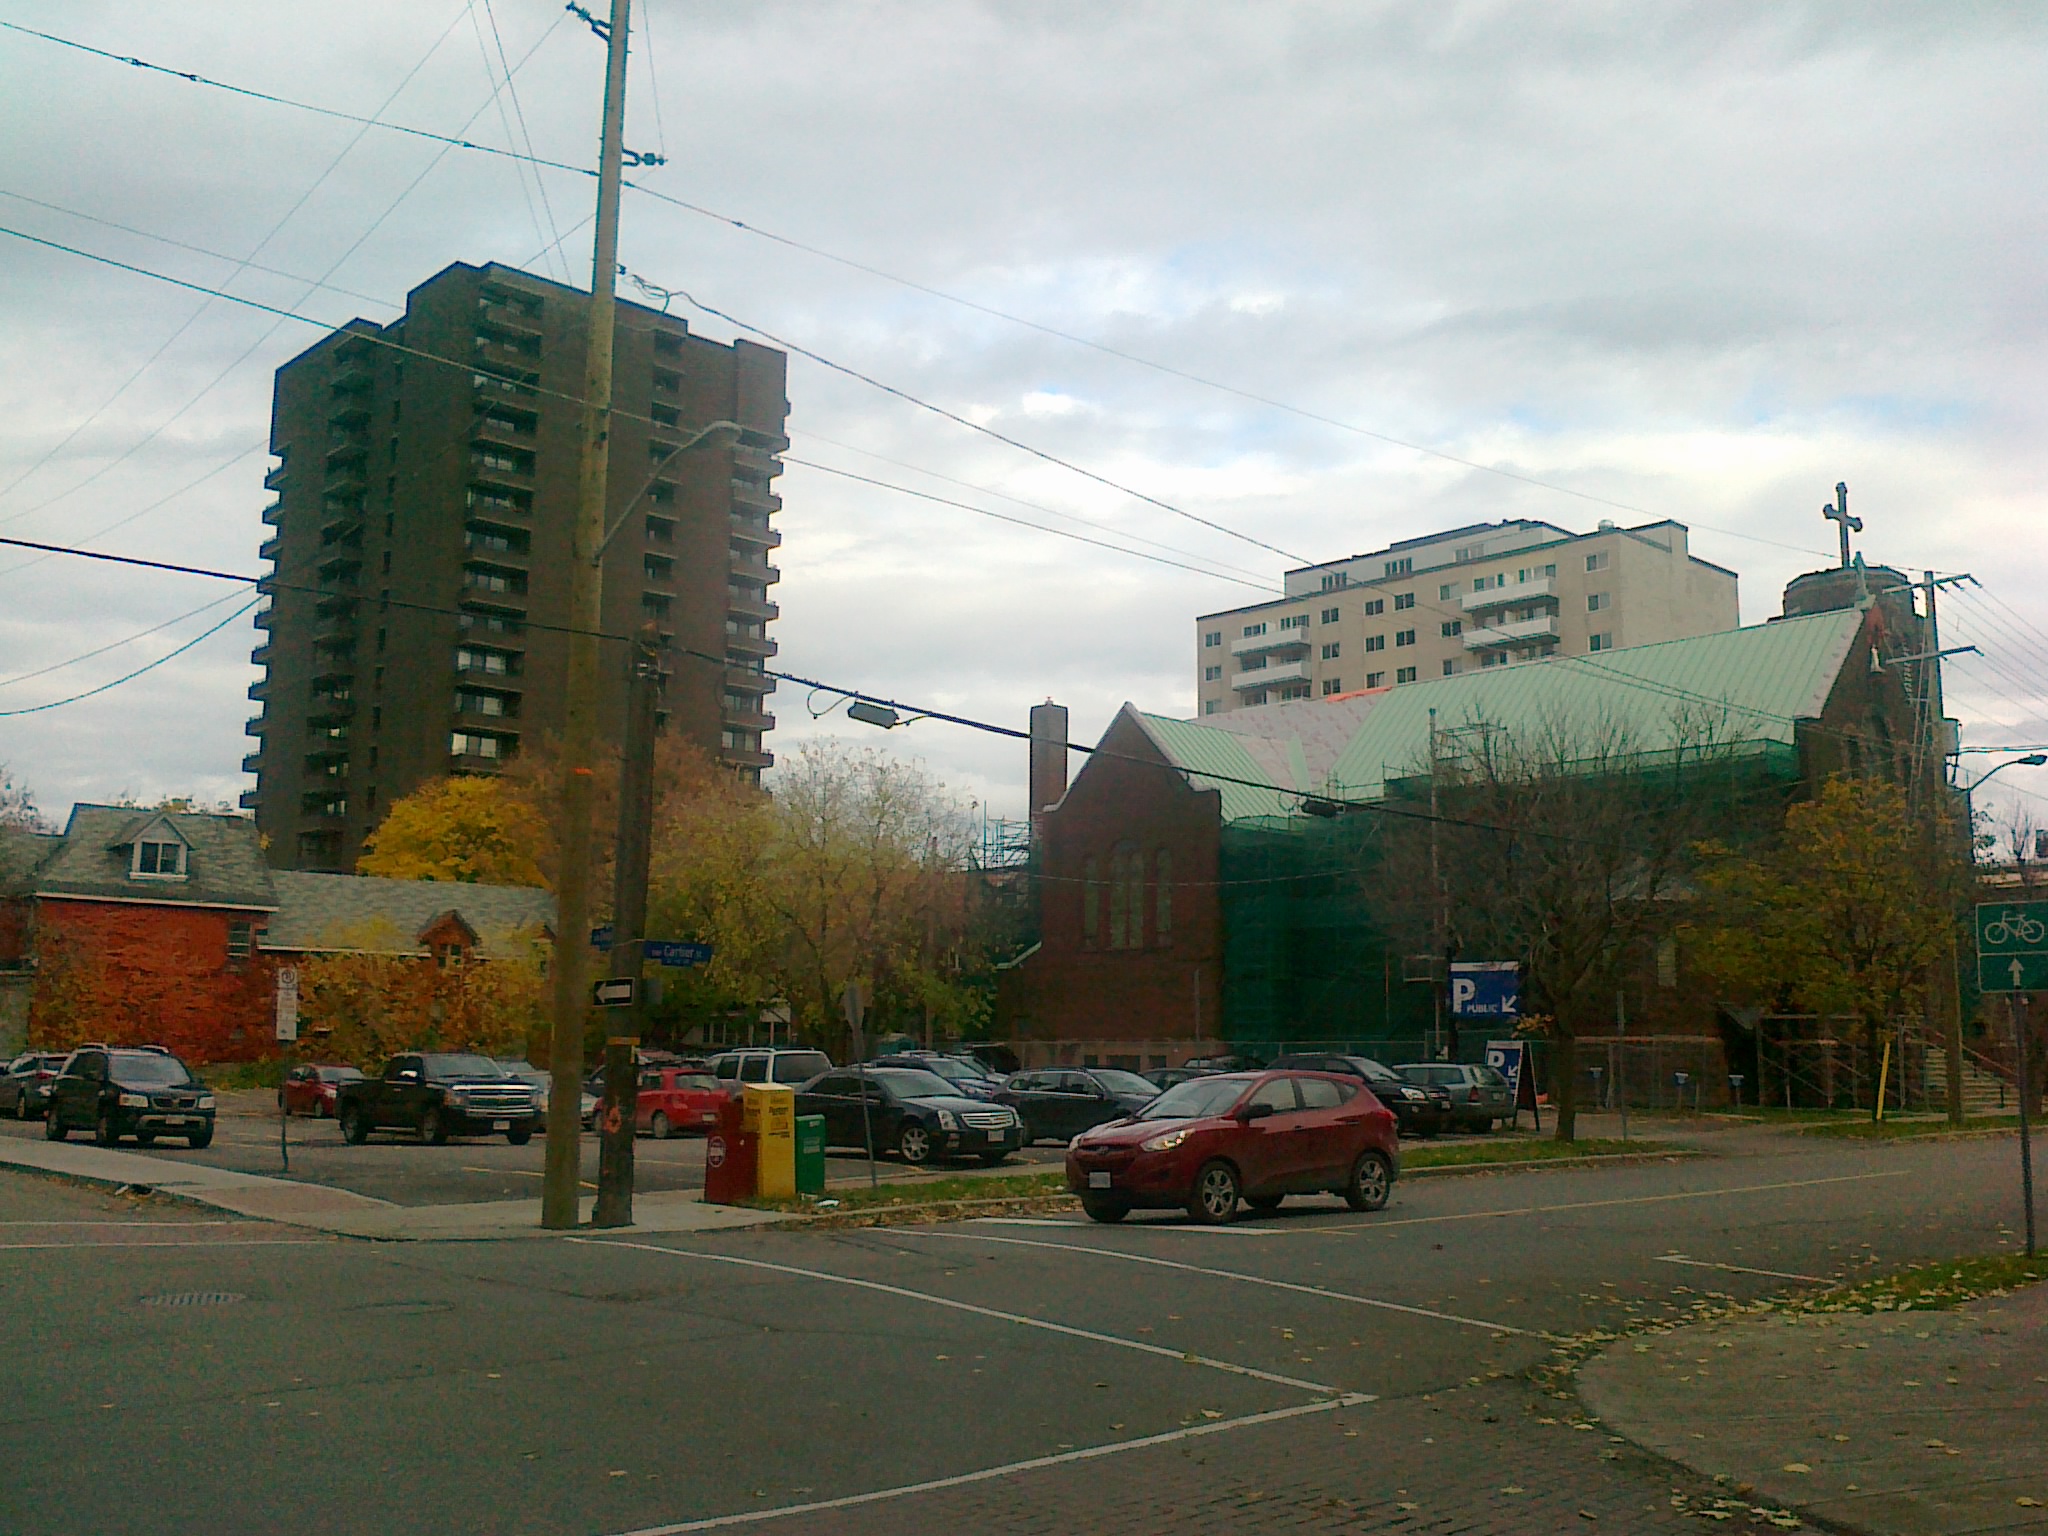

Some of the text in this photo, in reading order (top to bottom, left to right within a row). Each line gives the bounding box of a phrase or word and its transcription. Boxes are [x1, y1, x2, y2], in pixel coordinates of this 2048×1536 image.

[664, 945, 695, 959] Cartier
[1453, 978, 1498, 1013] P PUBLIC
